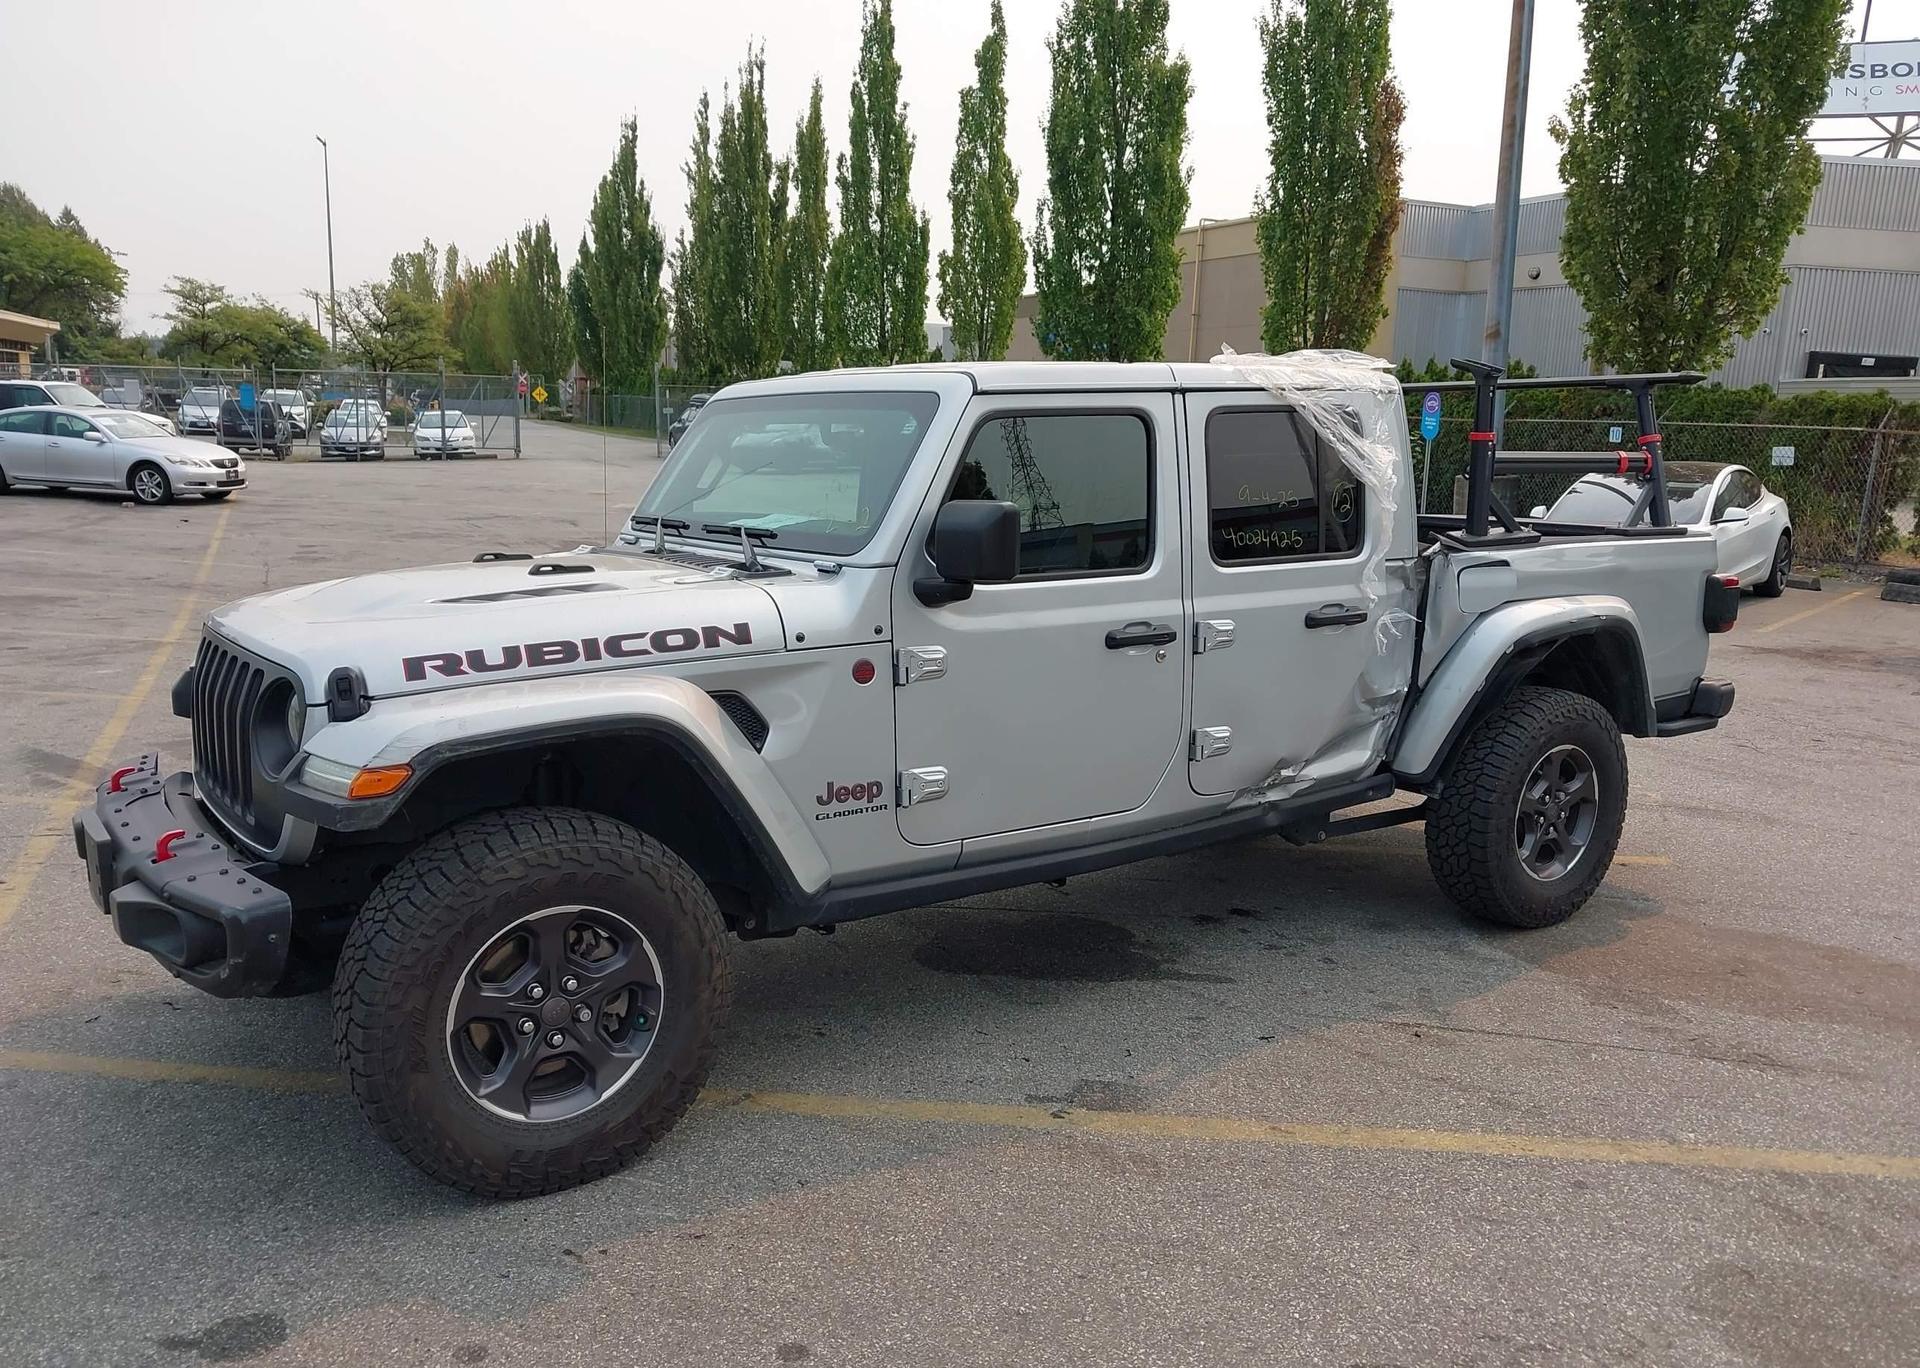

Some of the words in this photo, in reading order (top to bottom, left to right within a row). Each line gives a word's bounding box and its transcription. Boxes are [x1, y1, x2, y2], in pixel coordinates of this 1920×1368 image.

[1837, 62, 1920, 79] SBO
[1610, 428, 1621, 441] 10
[1334, 490, 1351, 513] 12
[402, 622, 754, 683] RUBICON
[816, 779, 883, 806] Jeep
[815, 803, 888, 821] GLADIATOR
